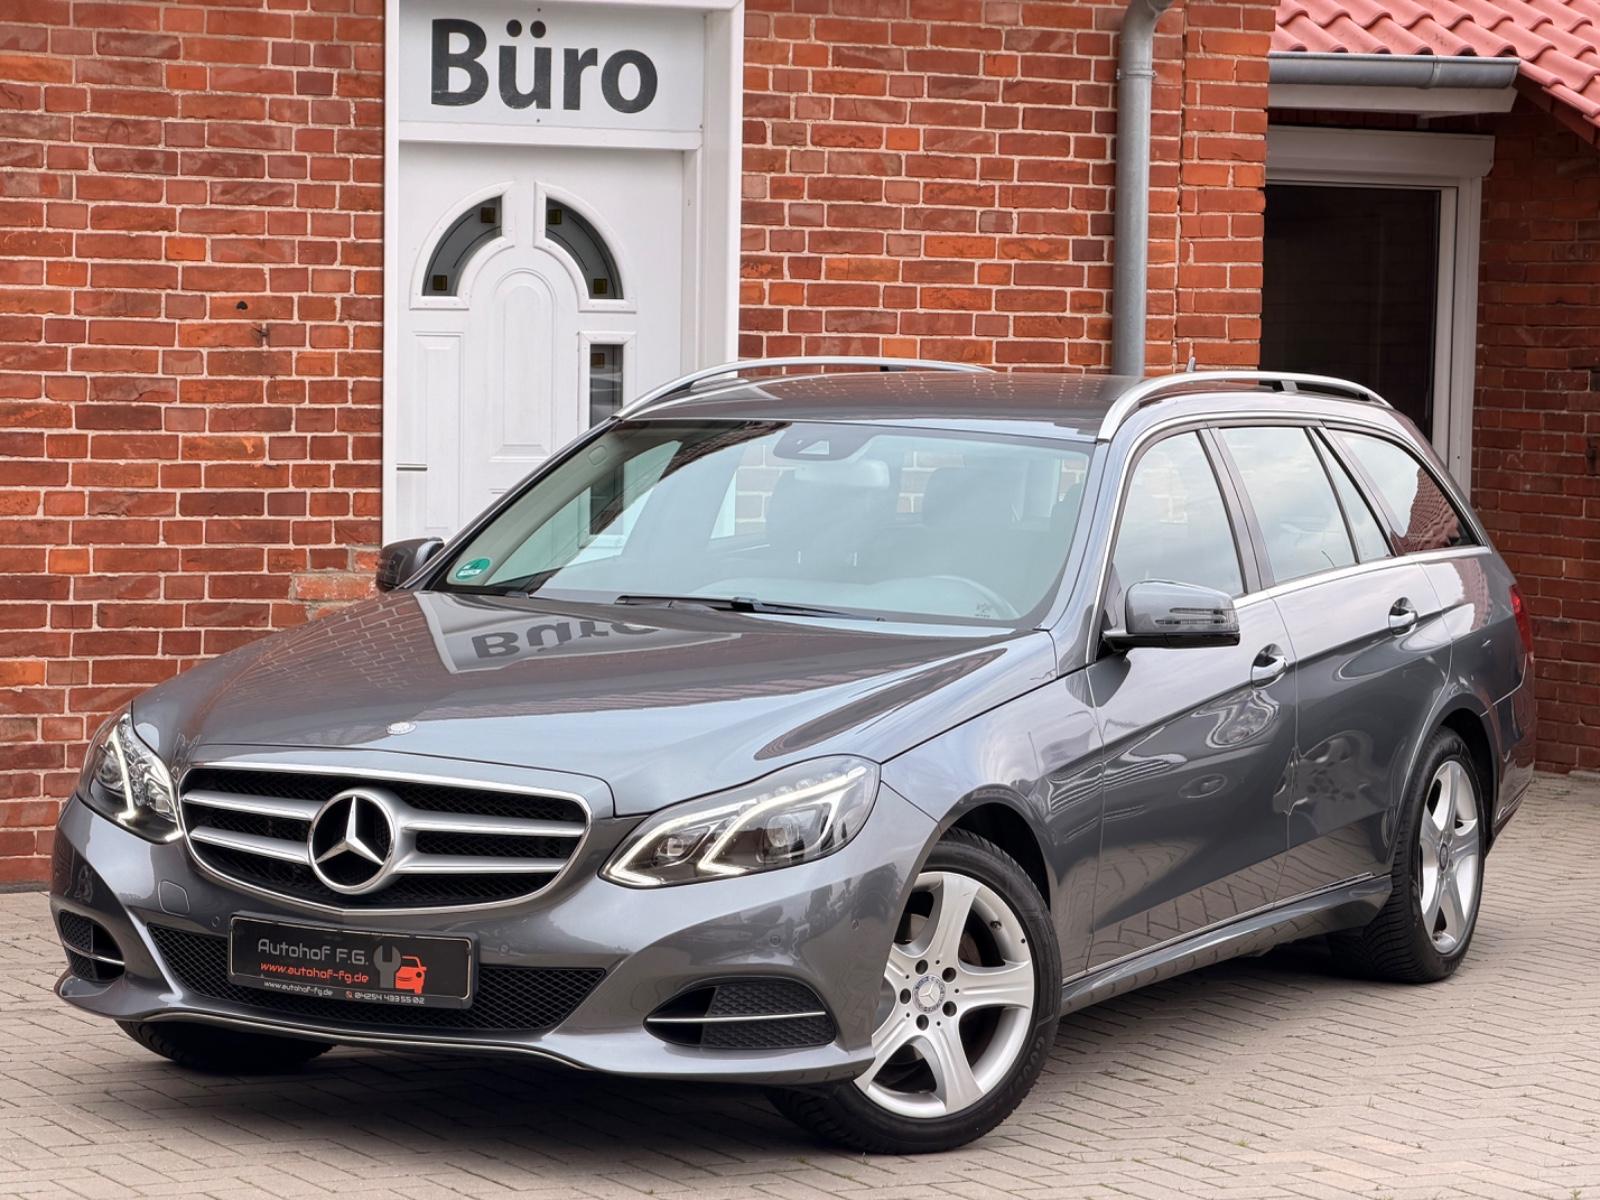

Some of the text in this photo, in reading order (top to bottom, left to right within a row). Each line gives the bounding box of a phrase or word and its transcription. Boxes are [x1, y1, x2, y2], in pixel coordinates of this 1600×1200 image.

[431, 18, 658, 114] Büro
[258, 938, 369, 965] Autohof F.G.
[260, 962, 369, 984] www.autohof-fg.de
[263, 981, 333, 997] www.autohof-fg.de
